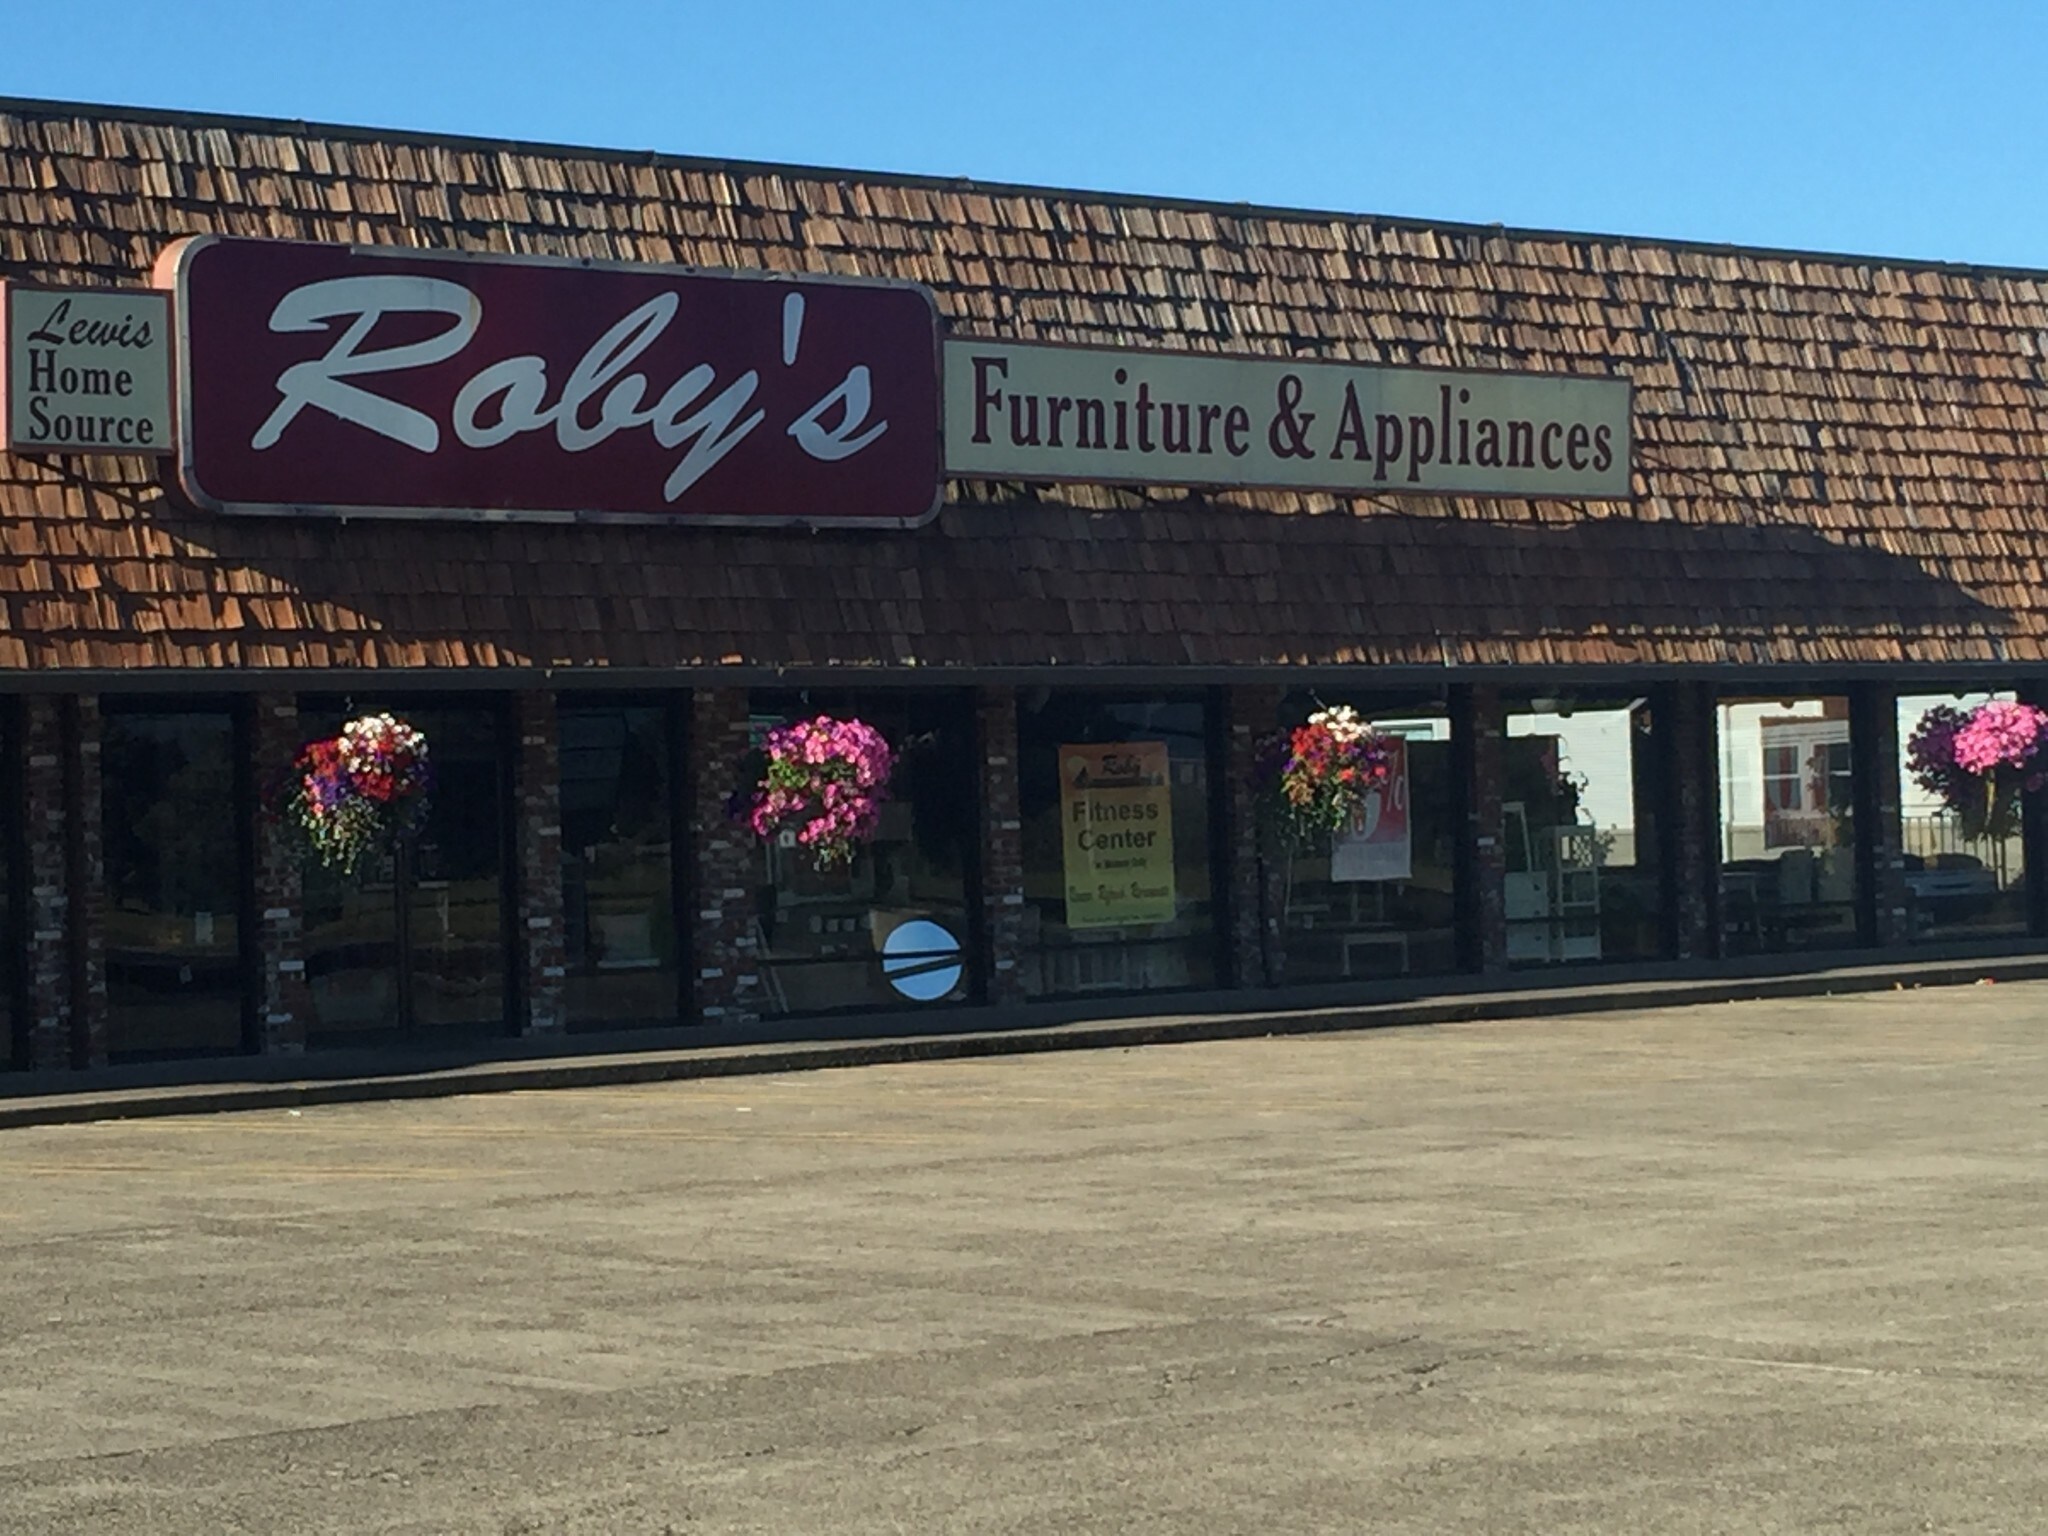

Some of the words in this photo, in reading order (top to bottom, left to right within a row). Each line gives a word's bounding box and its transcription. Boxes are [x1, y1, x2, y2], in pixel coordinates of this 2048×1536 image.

[27, 299, 153, 348] Lewis
[28, 349, 132, 396] Home
[252, 275, 888, 502] Roby's
[29, 396, 153, 444] Source
[971, 356, 1249, 457] Furniture
[1268, 374, 1315, 460] &
[1330, 379, 1612, 482] Appliances
[1072, 801, 1159, 823] Fitness
[1078, 828, 1156, 850] Center
